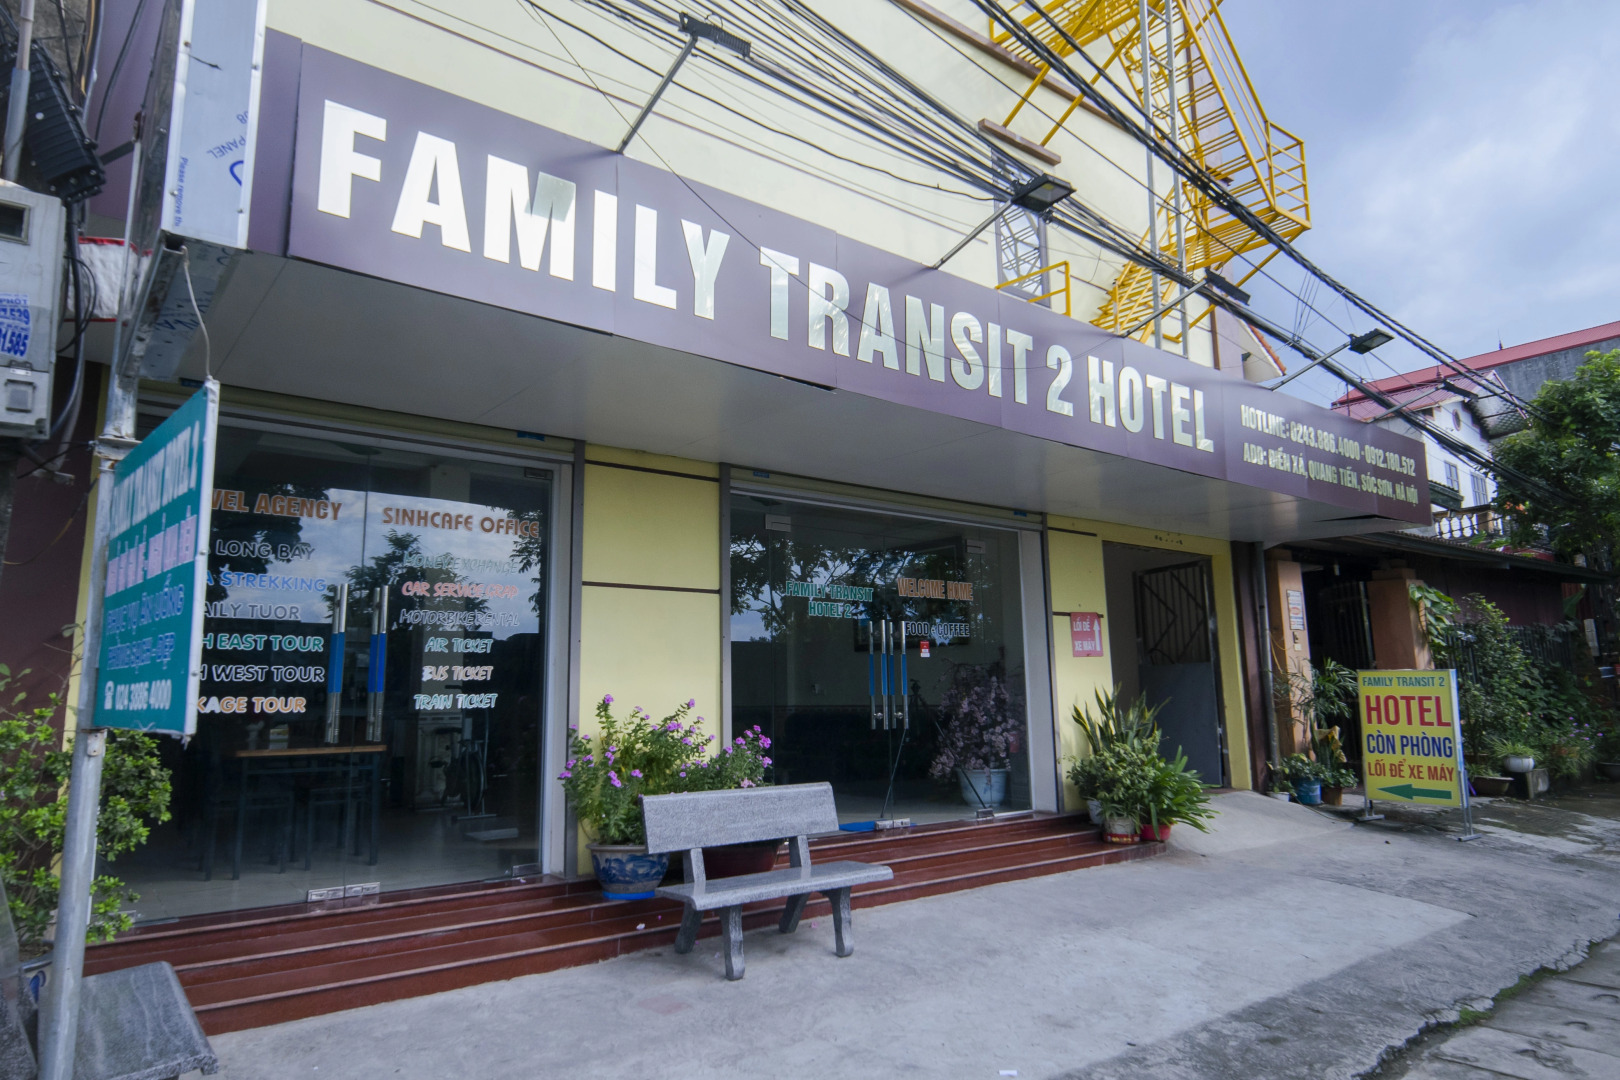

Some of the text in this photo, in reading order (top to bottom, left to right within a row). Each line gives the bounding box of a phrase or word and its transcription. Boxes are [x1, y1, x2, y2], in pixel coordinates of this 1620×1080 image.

[317, 99, 730, 321] FAMILY
[759, 246, 1033, 405] TRANSIT
[1046, 345, 1074, 417] 2
[1087, 355, 1214, 453] HOTEL
[1241, 404, 1290, 439] HOTLINE:
[1290, 421, 1360, 461] 0243.886.4000
[1243, 442, 1267, 466] ADD:
[1308, 460, 1338, 484] QUANG
[253, 493, 342, 520] AGENCY
[382, 507, 539, 538] SINHCAFE OFFICE
[216, 540, 315, 560] LONG BAY
[403, 550, 452, 569] MONEY
[220, 571, 326, 592] STREKKING
[401, 581, 430, 597] CAR
[433, 582, 483, 598] SERVICE
[785, 580, 874, 602] FAMILY TRANSIT
[897, 577, 974, 601] WELCOME HOME
[248, 604, 299, 619] TUOR
[808, 601, 852, 618] HOTEL 2
[905, 622, 929, 635] FOOD
[937, 623, 970, 637] COFFEE
[217, 633, 267, 650] EAST
[270, 635, 324, 652] TOUR
[424, 636, 494, 654] AIR TICKET
[212, 665, 268, 681] WEST
[271, 666, 325, 682] TOUR
[421, 665, 494, 682] BUS TICKET
[1362, 676, 1445, 687] FAMILY TRANSIT 2
[252, 696, 306, 713] TOUR
[413, 693, 498, 710] TRAIN TICKET
[1365, 695, 1452, 727] HOTEL
[1366, 730, 1453, 758] CÒN PHÒNG
[1368, 758, 1454, 782] LỐI ĐỂ XE MÁY
